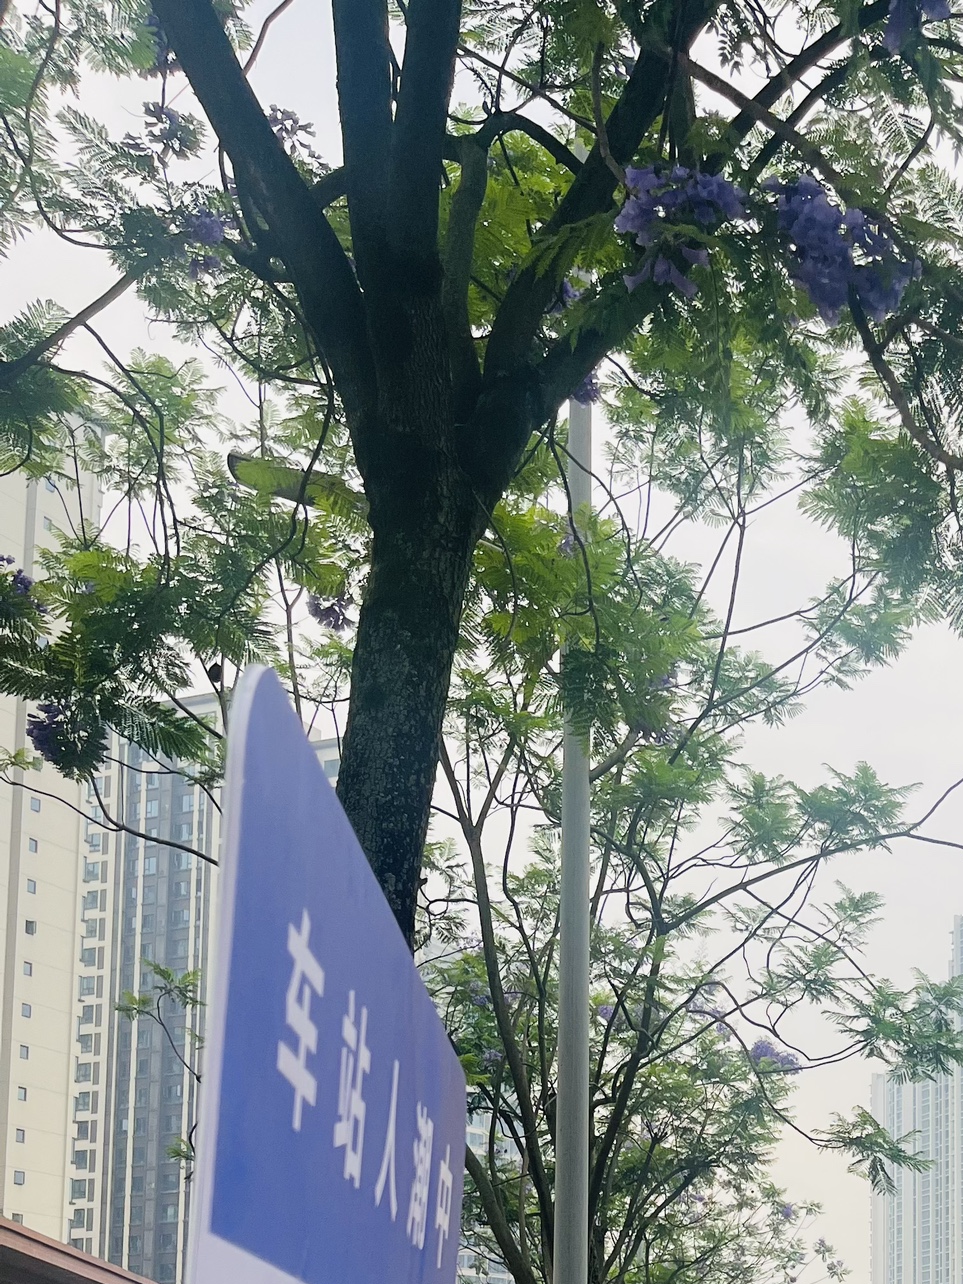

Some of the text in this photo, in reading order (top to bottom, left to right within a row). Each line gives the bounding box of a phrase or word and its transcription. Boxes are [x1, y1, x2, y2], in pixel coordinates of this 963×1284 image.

[277, 908, 453, 1269] 车站人潮中
